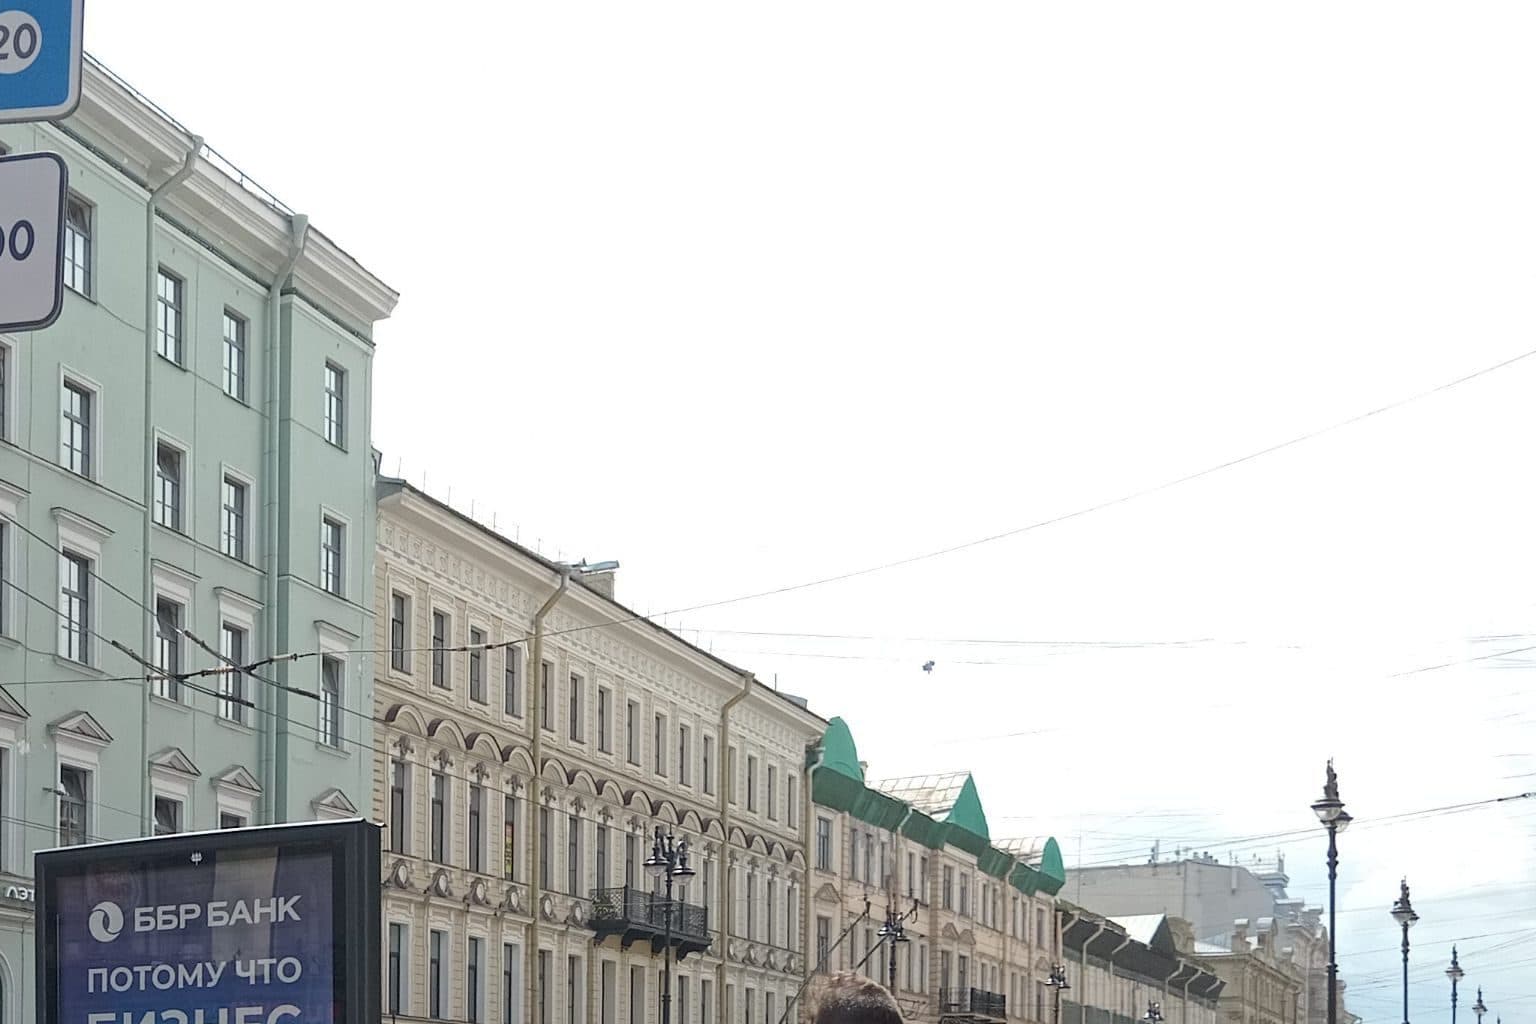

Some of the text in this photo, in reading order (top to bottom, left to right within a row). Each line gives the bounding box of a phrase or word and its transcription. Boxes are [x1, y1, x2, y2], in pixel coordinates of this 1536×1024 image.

[133, 895, 302, 933] ББР БАНК
[87, 956, 303, 994] ПОТОМУ ЧТО
